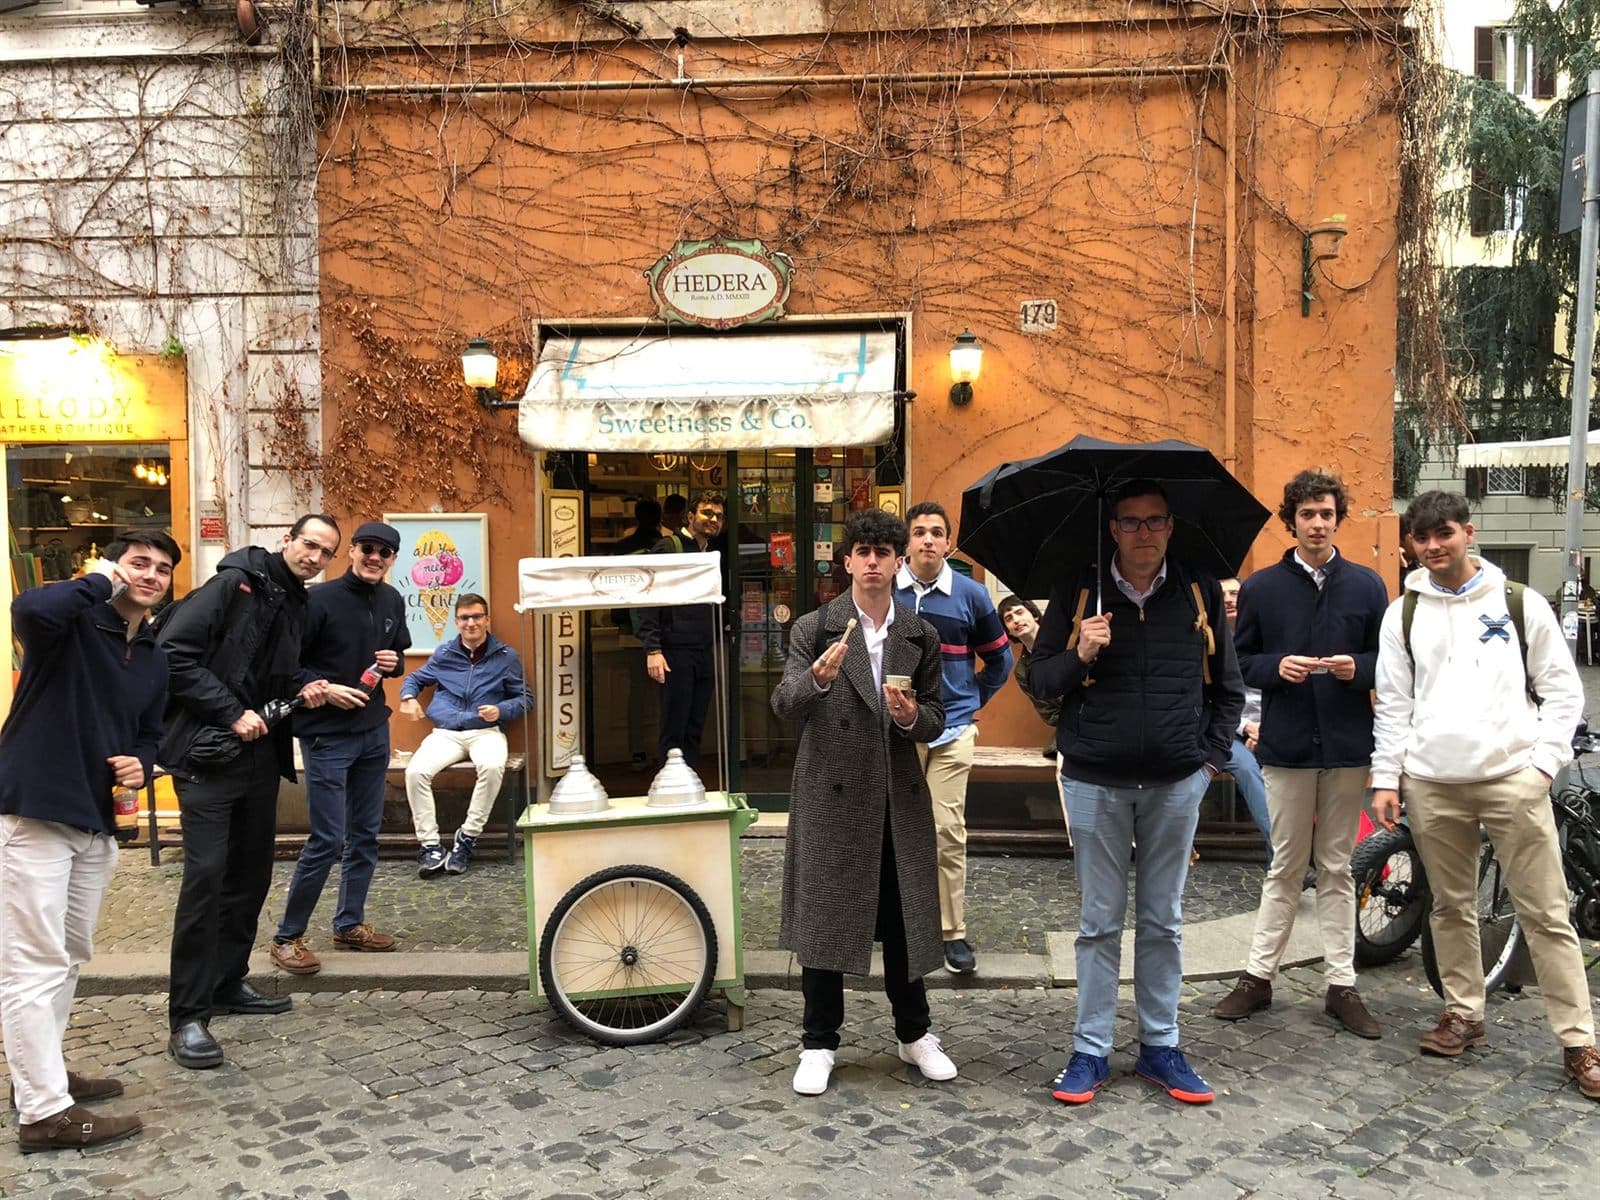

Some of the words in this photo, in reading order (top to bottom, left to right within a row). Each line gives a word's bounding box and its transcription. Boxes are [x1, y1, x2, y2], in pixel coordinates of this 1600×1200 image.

[674, 273, 767, 292] HEDERA
[1021, 304, 1055, 324] 179
[0, 398, 132, 419] ELODY
[55, 423, 134, 434] BOUTIQUE
[598, 412, 732, 434] Sweetness
[741, 408, 762, 430] &
[771, 408, 812, 429] Co.
[413, 541, 434, 556] all
[424, 557, 450, 573] need
[428, 576, 440, 591] is
[599, 574, 645, 585] HEDERA
[430, 593, 460, 608] CRE
